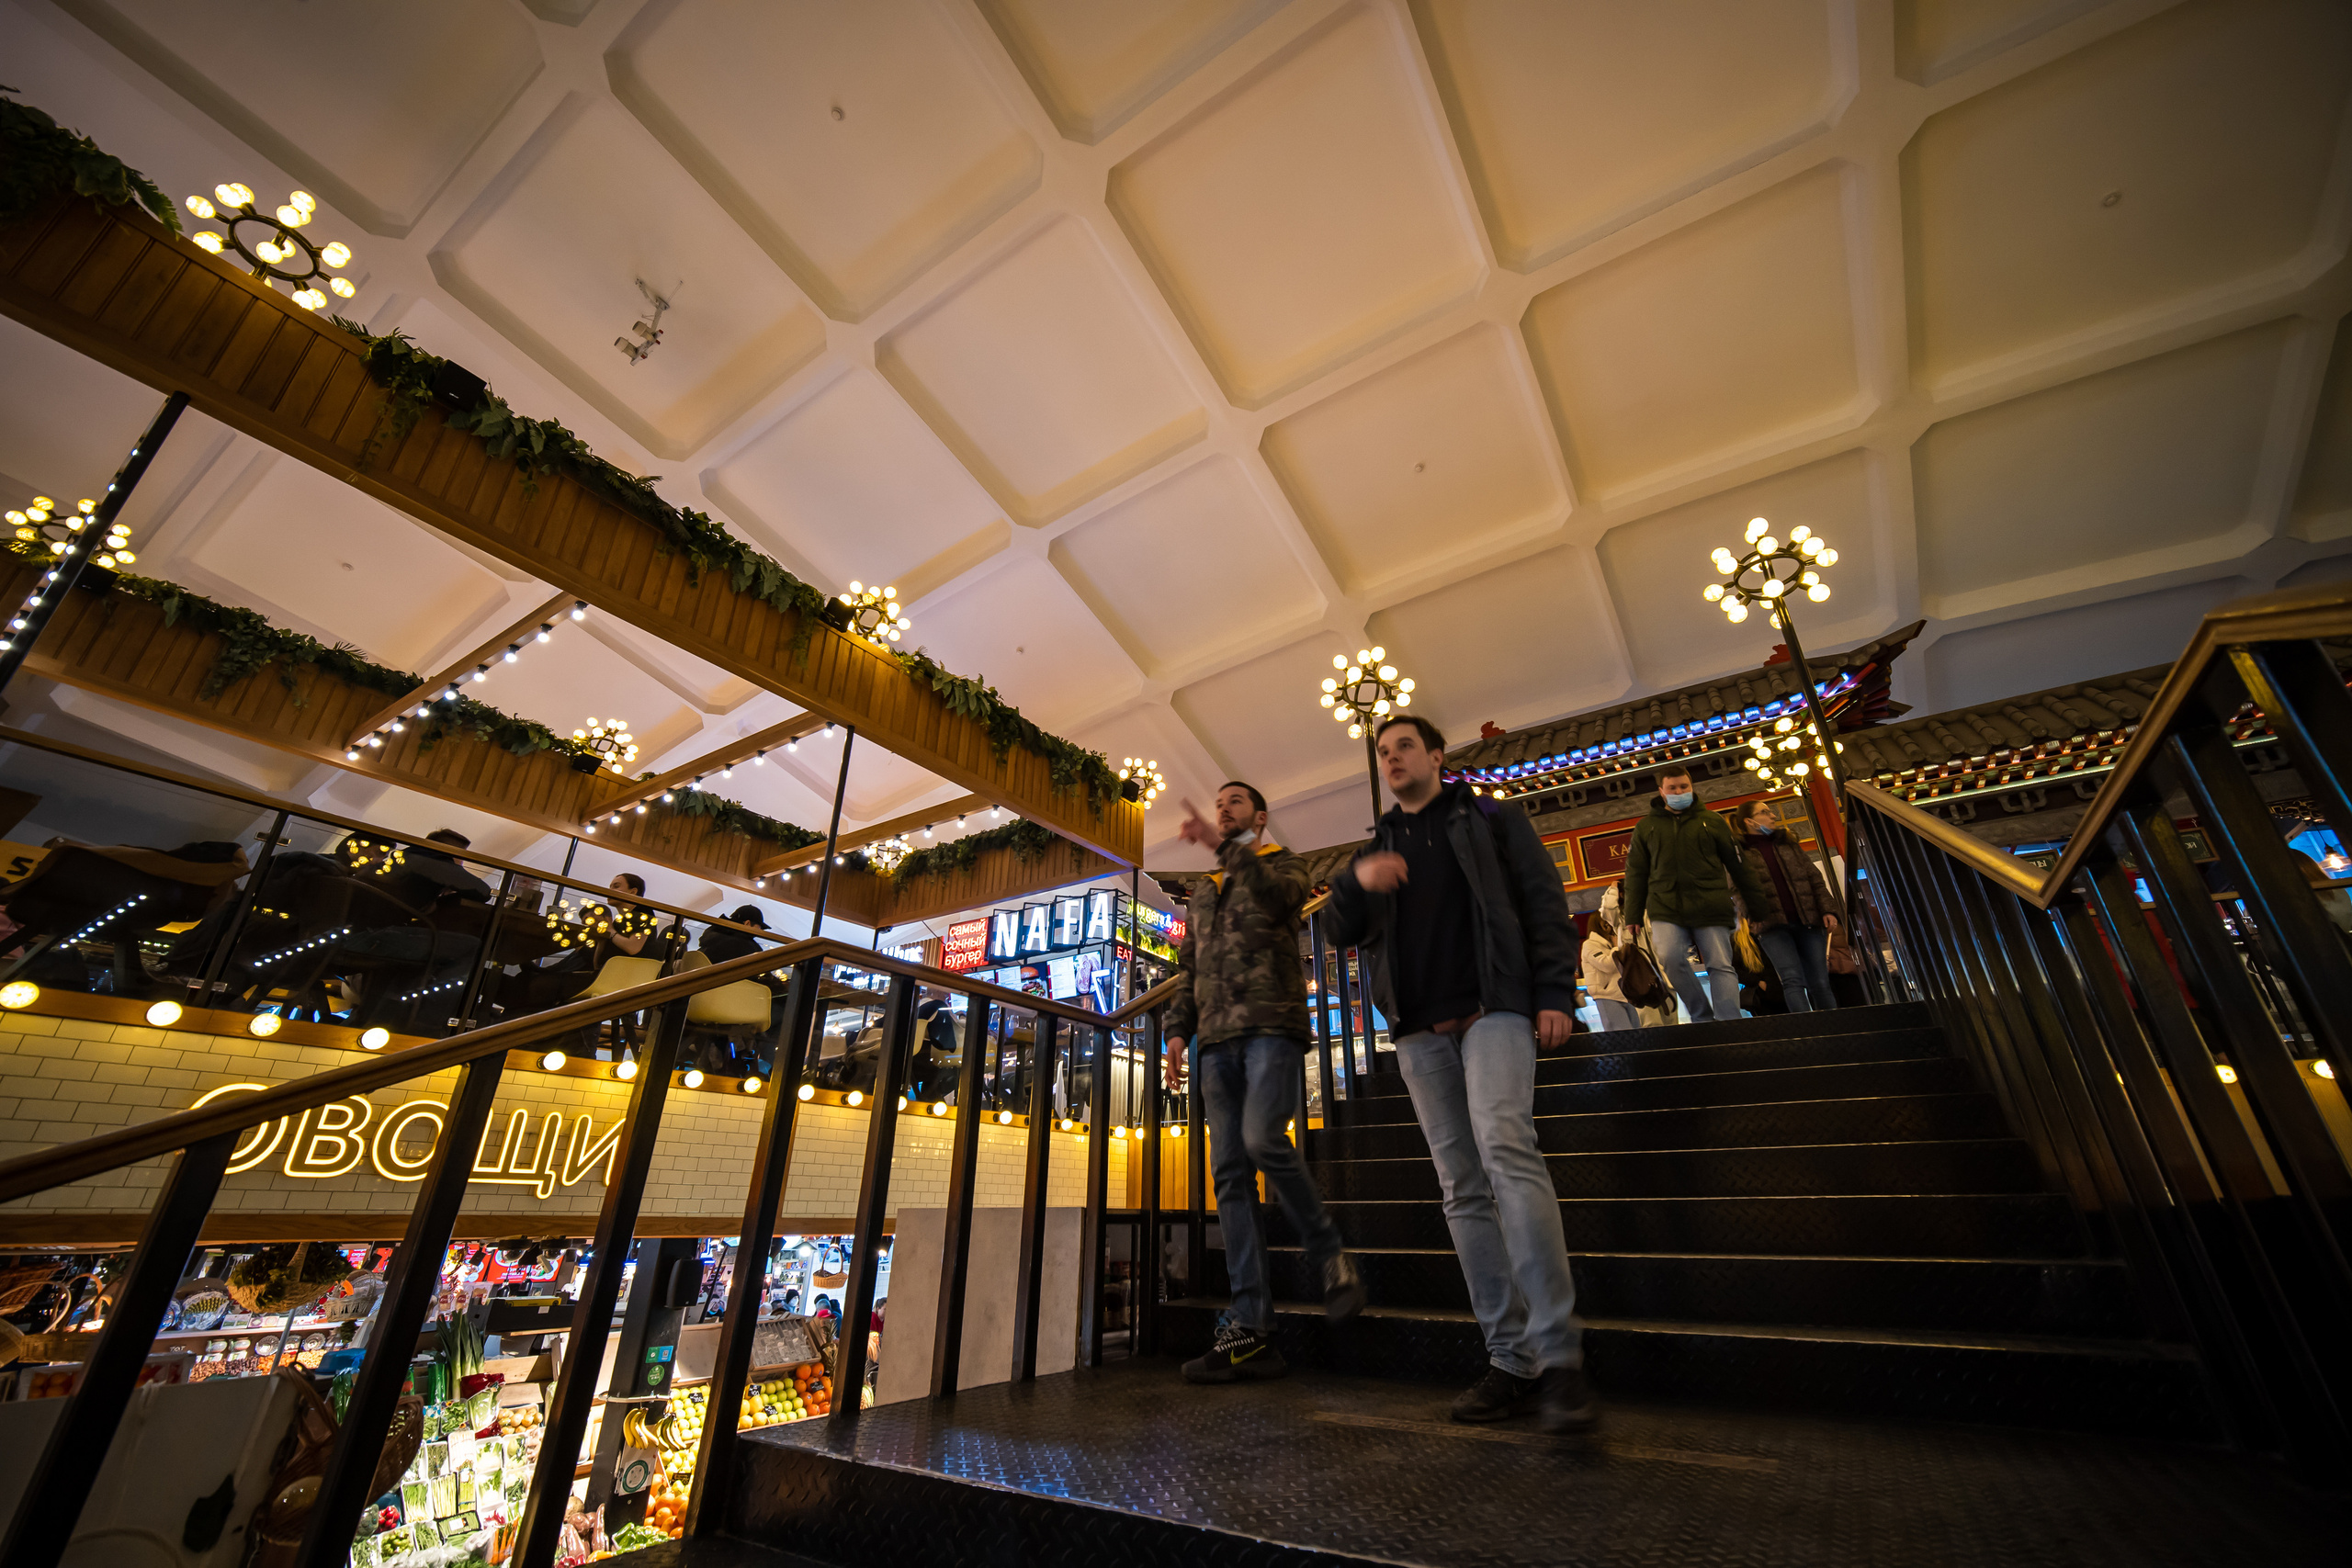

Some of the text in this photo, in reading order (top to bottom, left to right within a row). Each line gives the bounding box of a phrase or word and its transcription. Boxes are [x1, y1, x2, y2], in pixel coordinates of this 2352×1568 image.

[949, 919, 986, 937] самый
[994, 892, 1110, 957] NAFA
[944, 932, 986, 953] сочный
[944, 950, 982, 969] бургер
[1116, 945, 1133, 962] EAT
[189, 1082, 628, 1200] ОВОЩИ
